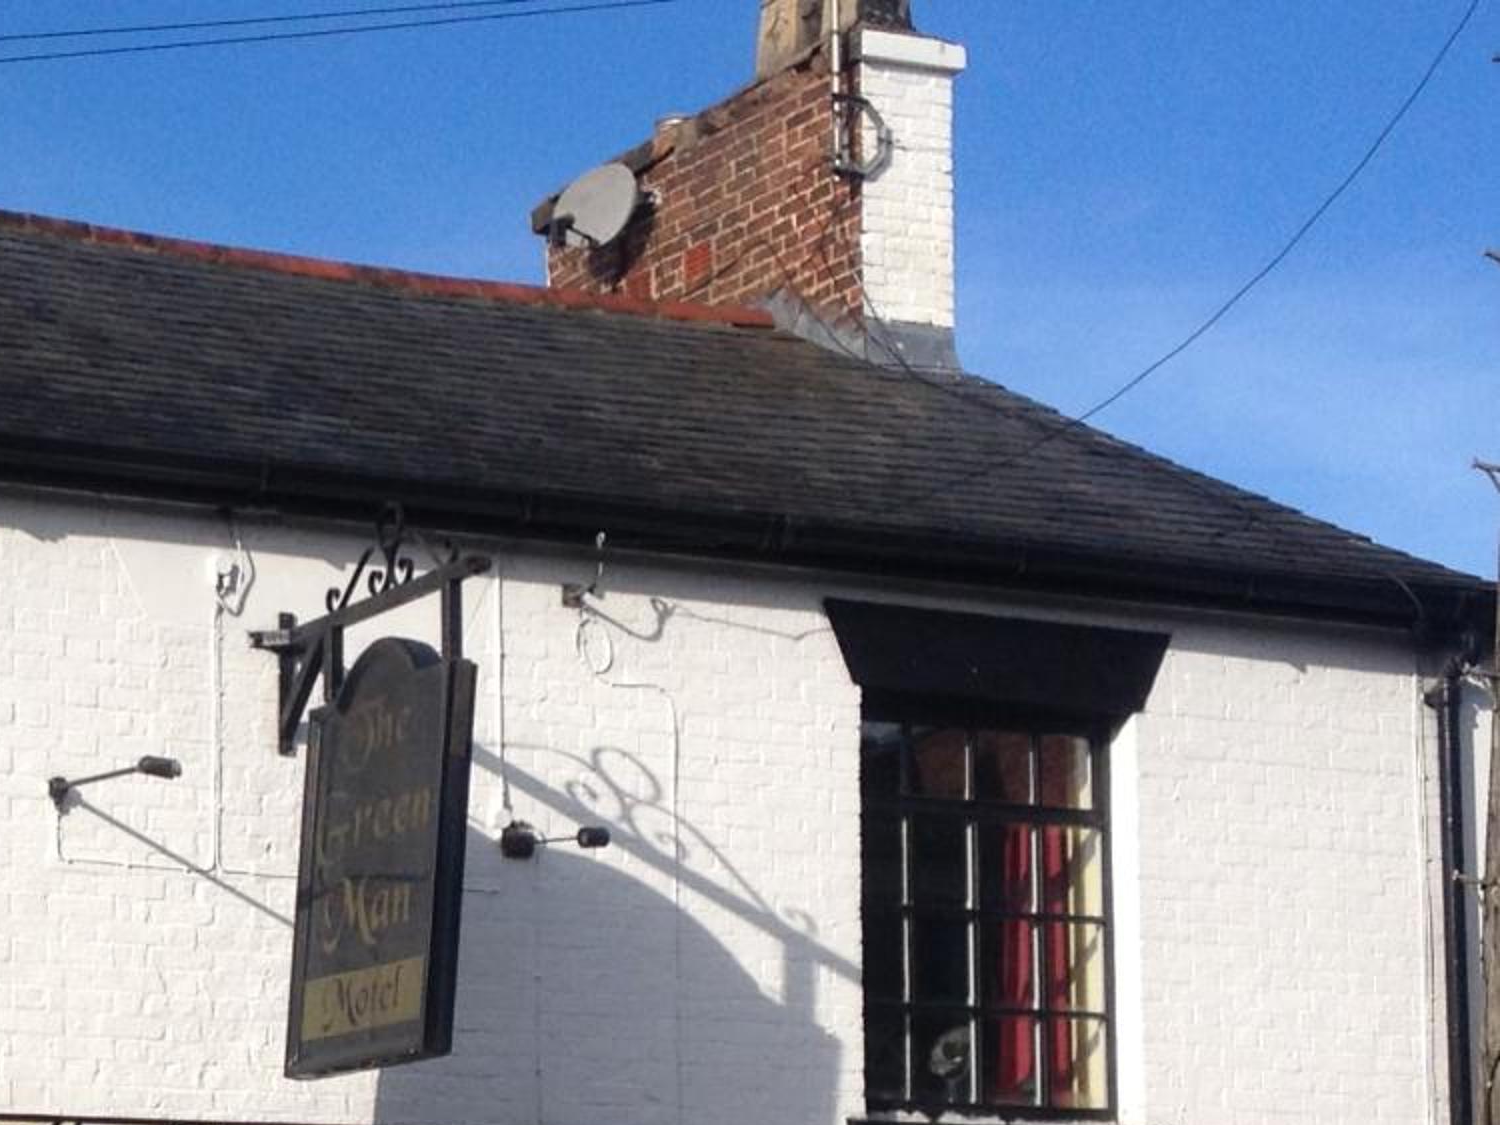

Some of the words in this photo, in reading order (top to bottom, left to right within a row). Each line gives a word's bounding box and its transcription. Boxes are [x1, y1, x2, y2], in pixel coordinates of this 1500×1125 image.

[341, 699, 413, 774] The
[318, 785, 432, 866] Green
[323, 876, 411, 954] Man
[322, 965, 404, 1032] Motel
